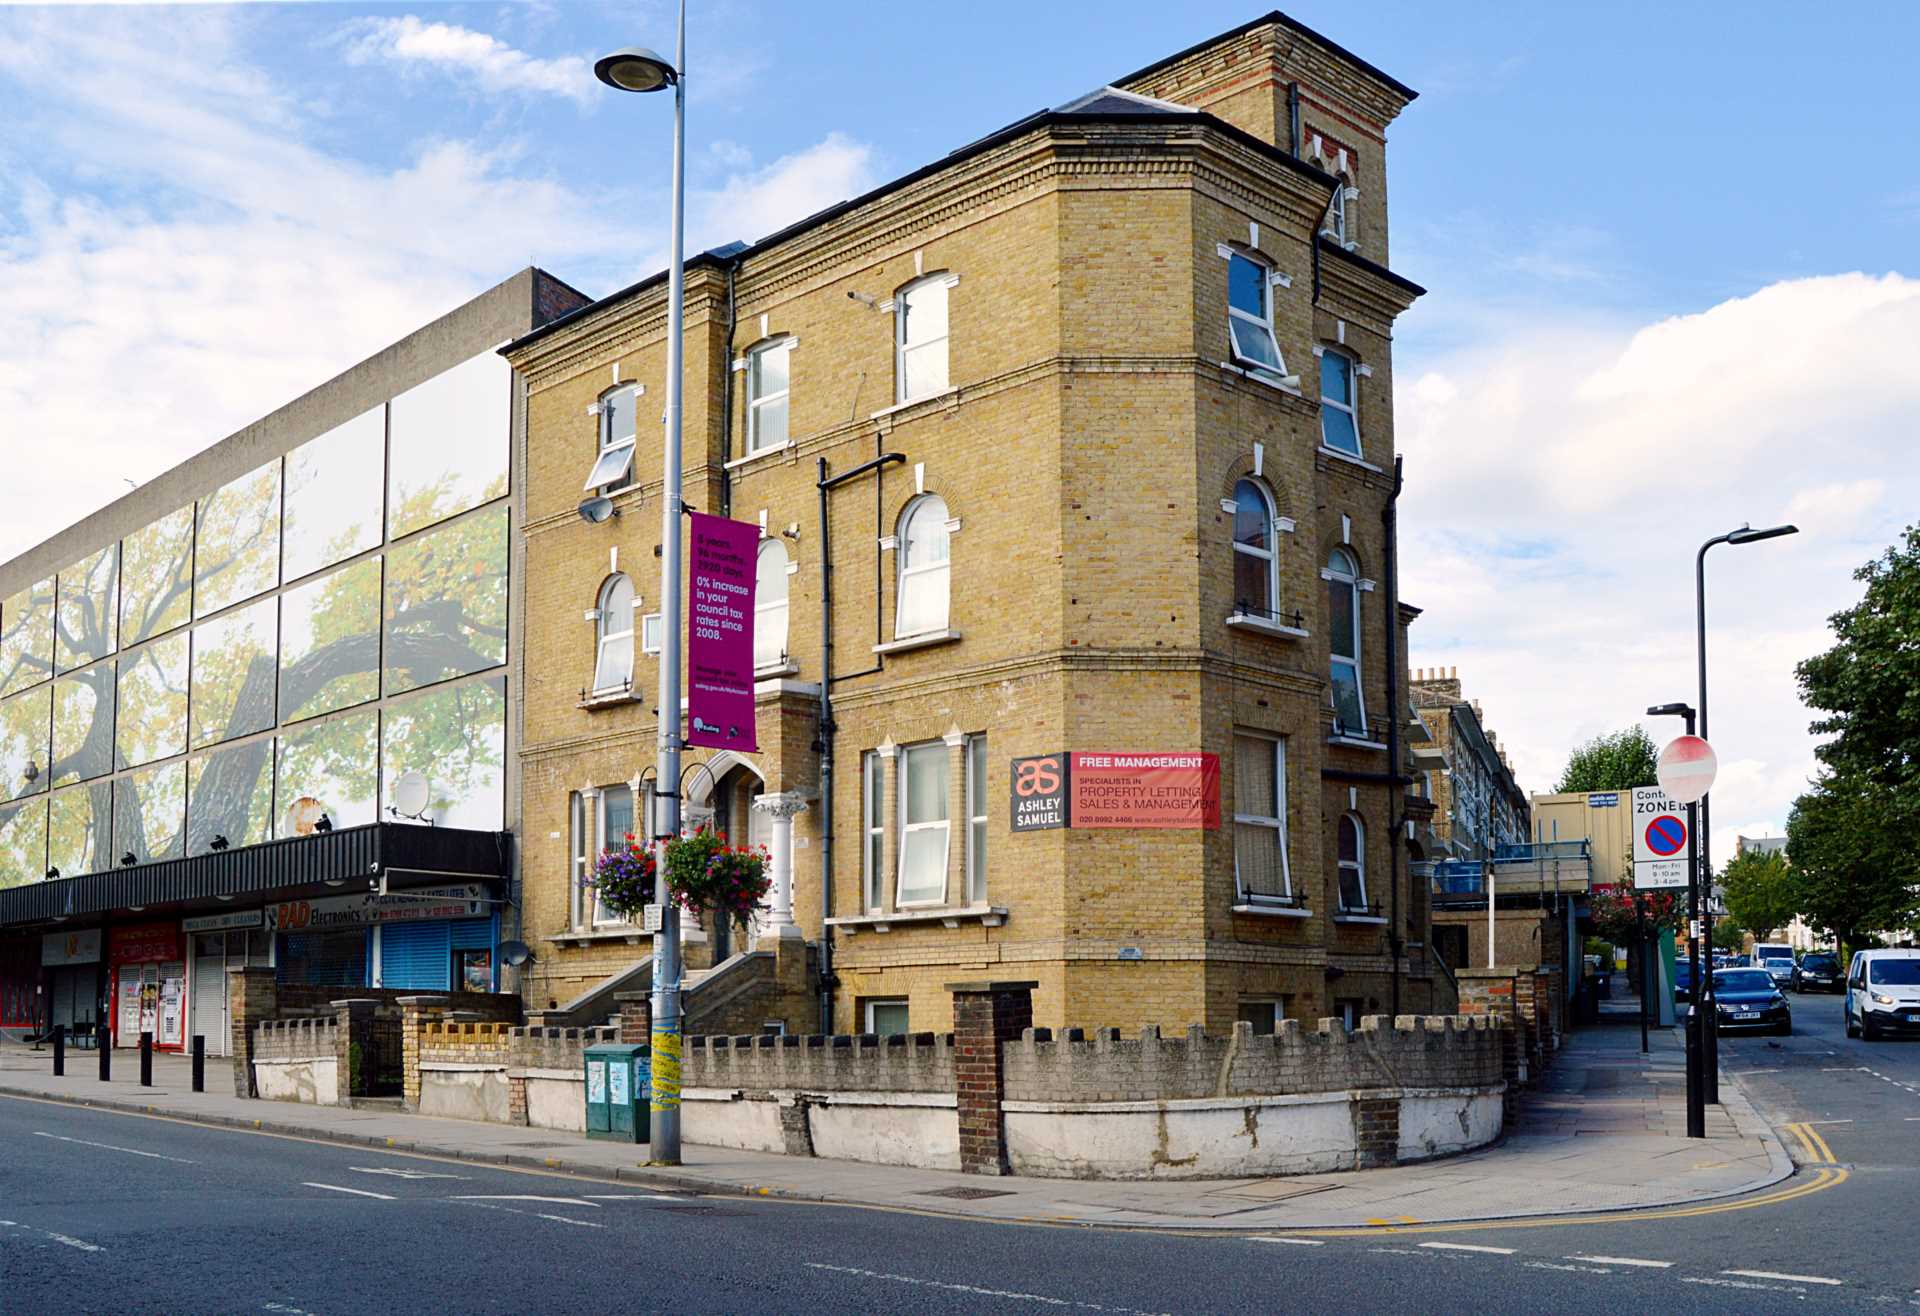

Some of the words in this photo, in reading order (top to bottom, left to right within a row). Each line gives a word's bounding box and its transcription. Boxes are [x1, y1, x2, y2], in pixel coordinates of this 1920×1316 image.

[696, 575, 710, 588] 0%
[712, 579, 749, 596] increase
[696, 588, 705, 599] in
[707, 592, 728, 604] your
[696, 603, 729, 616] council
[730, 607, 744, 620] tax
[696, 616, 720, 628] rates
[721, 618, 743, 632] since
[696, 627, 723, 641] 2008.
[1079, 756, 1112, 768] FREE
[1114, 756, 1203, 768] MANAGEMENT
[1079, 777, 1131, 785] SPECIALISTS
[1132, 777, 1142, 785] IN
[1079, 786, 1146, 797] PROPERTY
[1018, 797, 1061, 813] ASHLEY
[1079, 799, 1120, 809] SALES
[1122, 799, 1131, 809] &
[1134, 799, 1216, 809] MANAGEMENT
[1637, 800, 1677, 813] ZONE
[1017, 812, 1062, 827] SAMUEL
[278, 901, 310, 929] RAD
